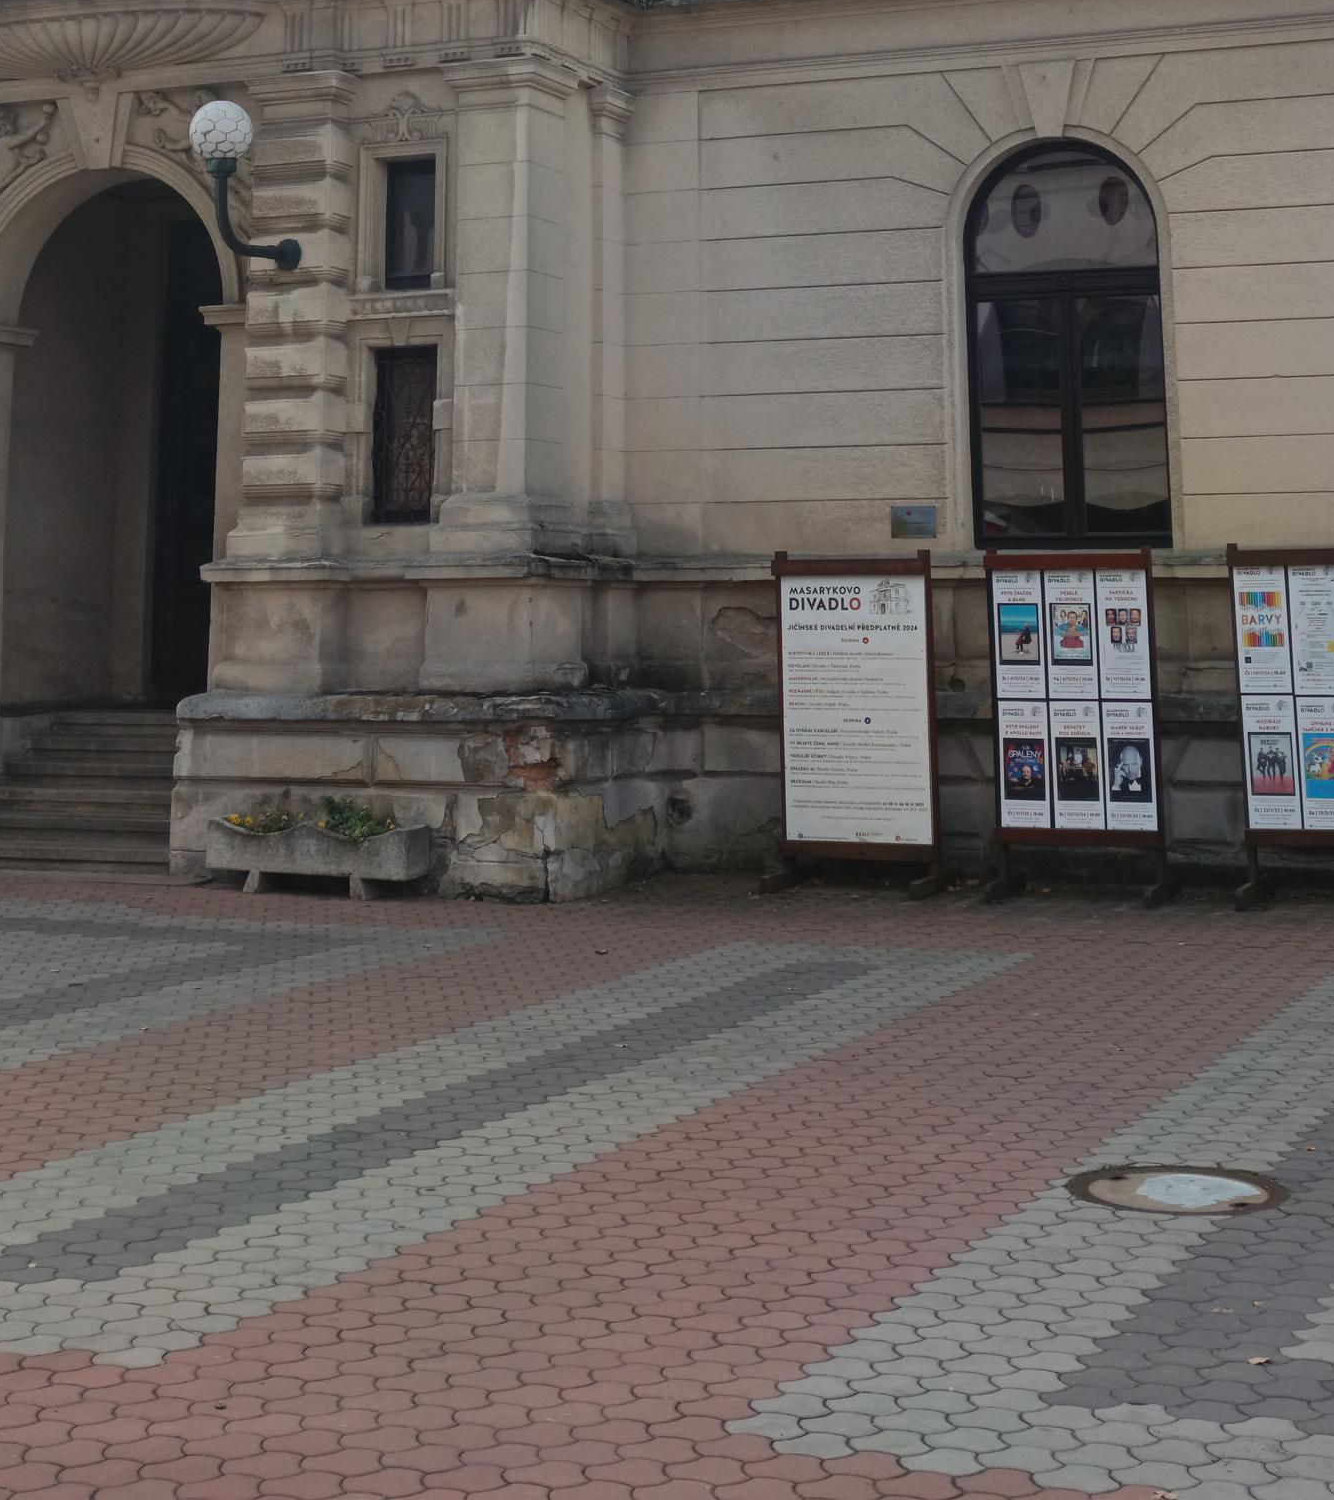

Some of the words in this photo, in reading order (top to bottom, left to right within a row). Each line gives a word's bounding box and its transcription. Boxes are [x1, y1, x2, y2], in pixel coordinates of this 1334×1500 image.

[789, 586, 861, 596] MASARYKOVO
[789, 597, 862, 612] DIVADLO
[1241, 614, 1282, 625] BARVY
